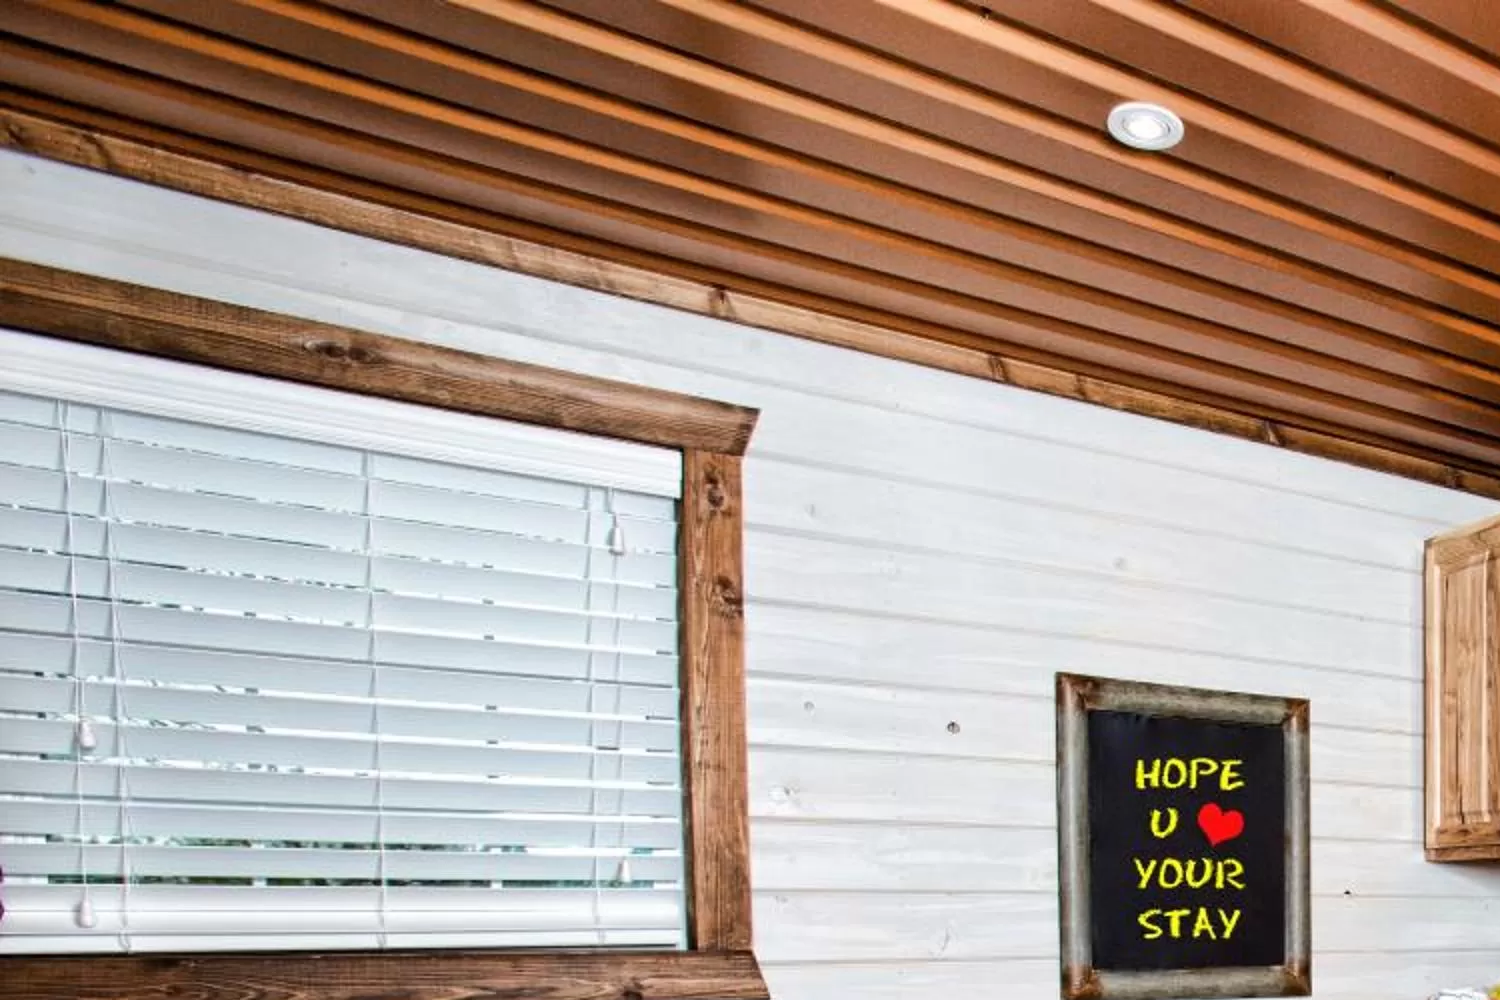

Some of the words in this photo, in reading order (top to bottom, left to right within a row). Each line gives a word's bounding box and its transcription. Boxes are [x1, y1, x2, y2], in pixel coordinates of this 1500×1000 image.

[1135, 757, 1245, 791] HOPE
[1151, 807, 1179, 839] U
[1133, 857, 1246, 890] YOUR
[1137, 906, 1241, 940] STAY
